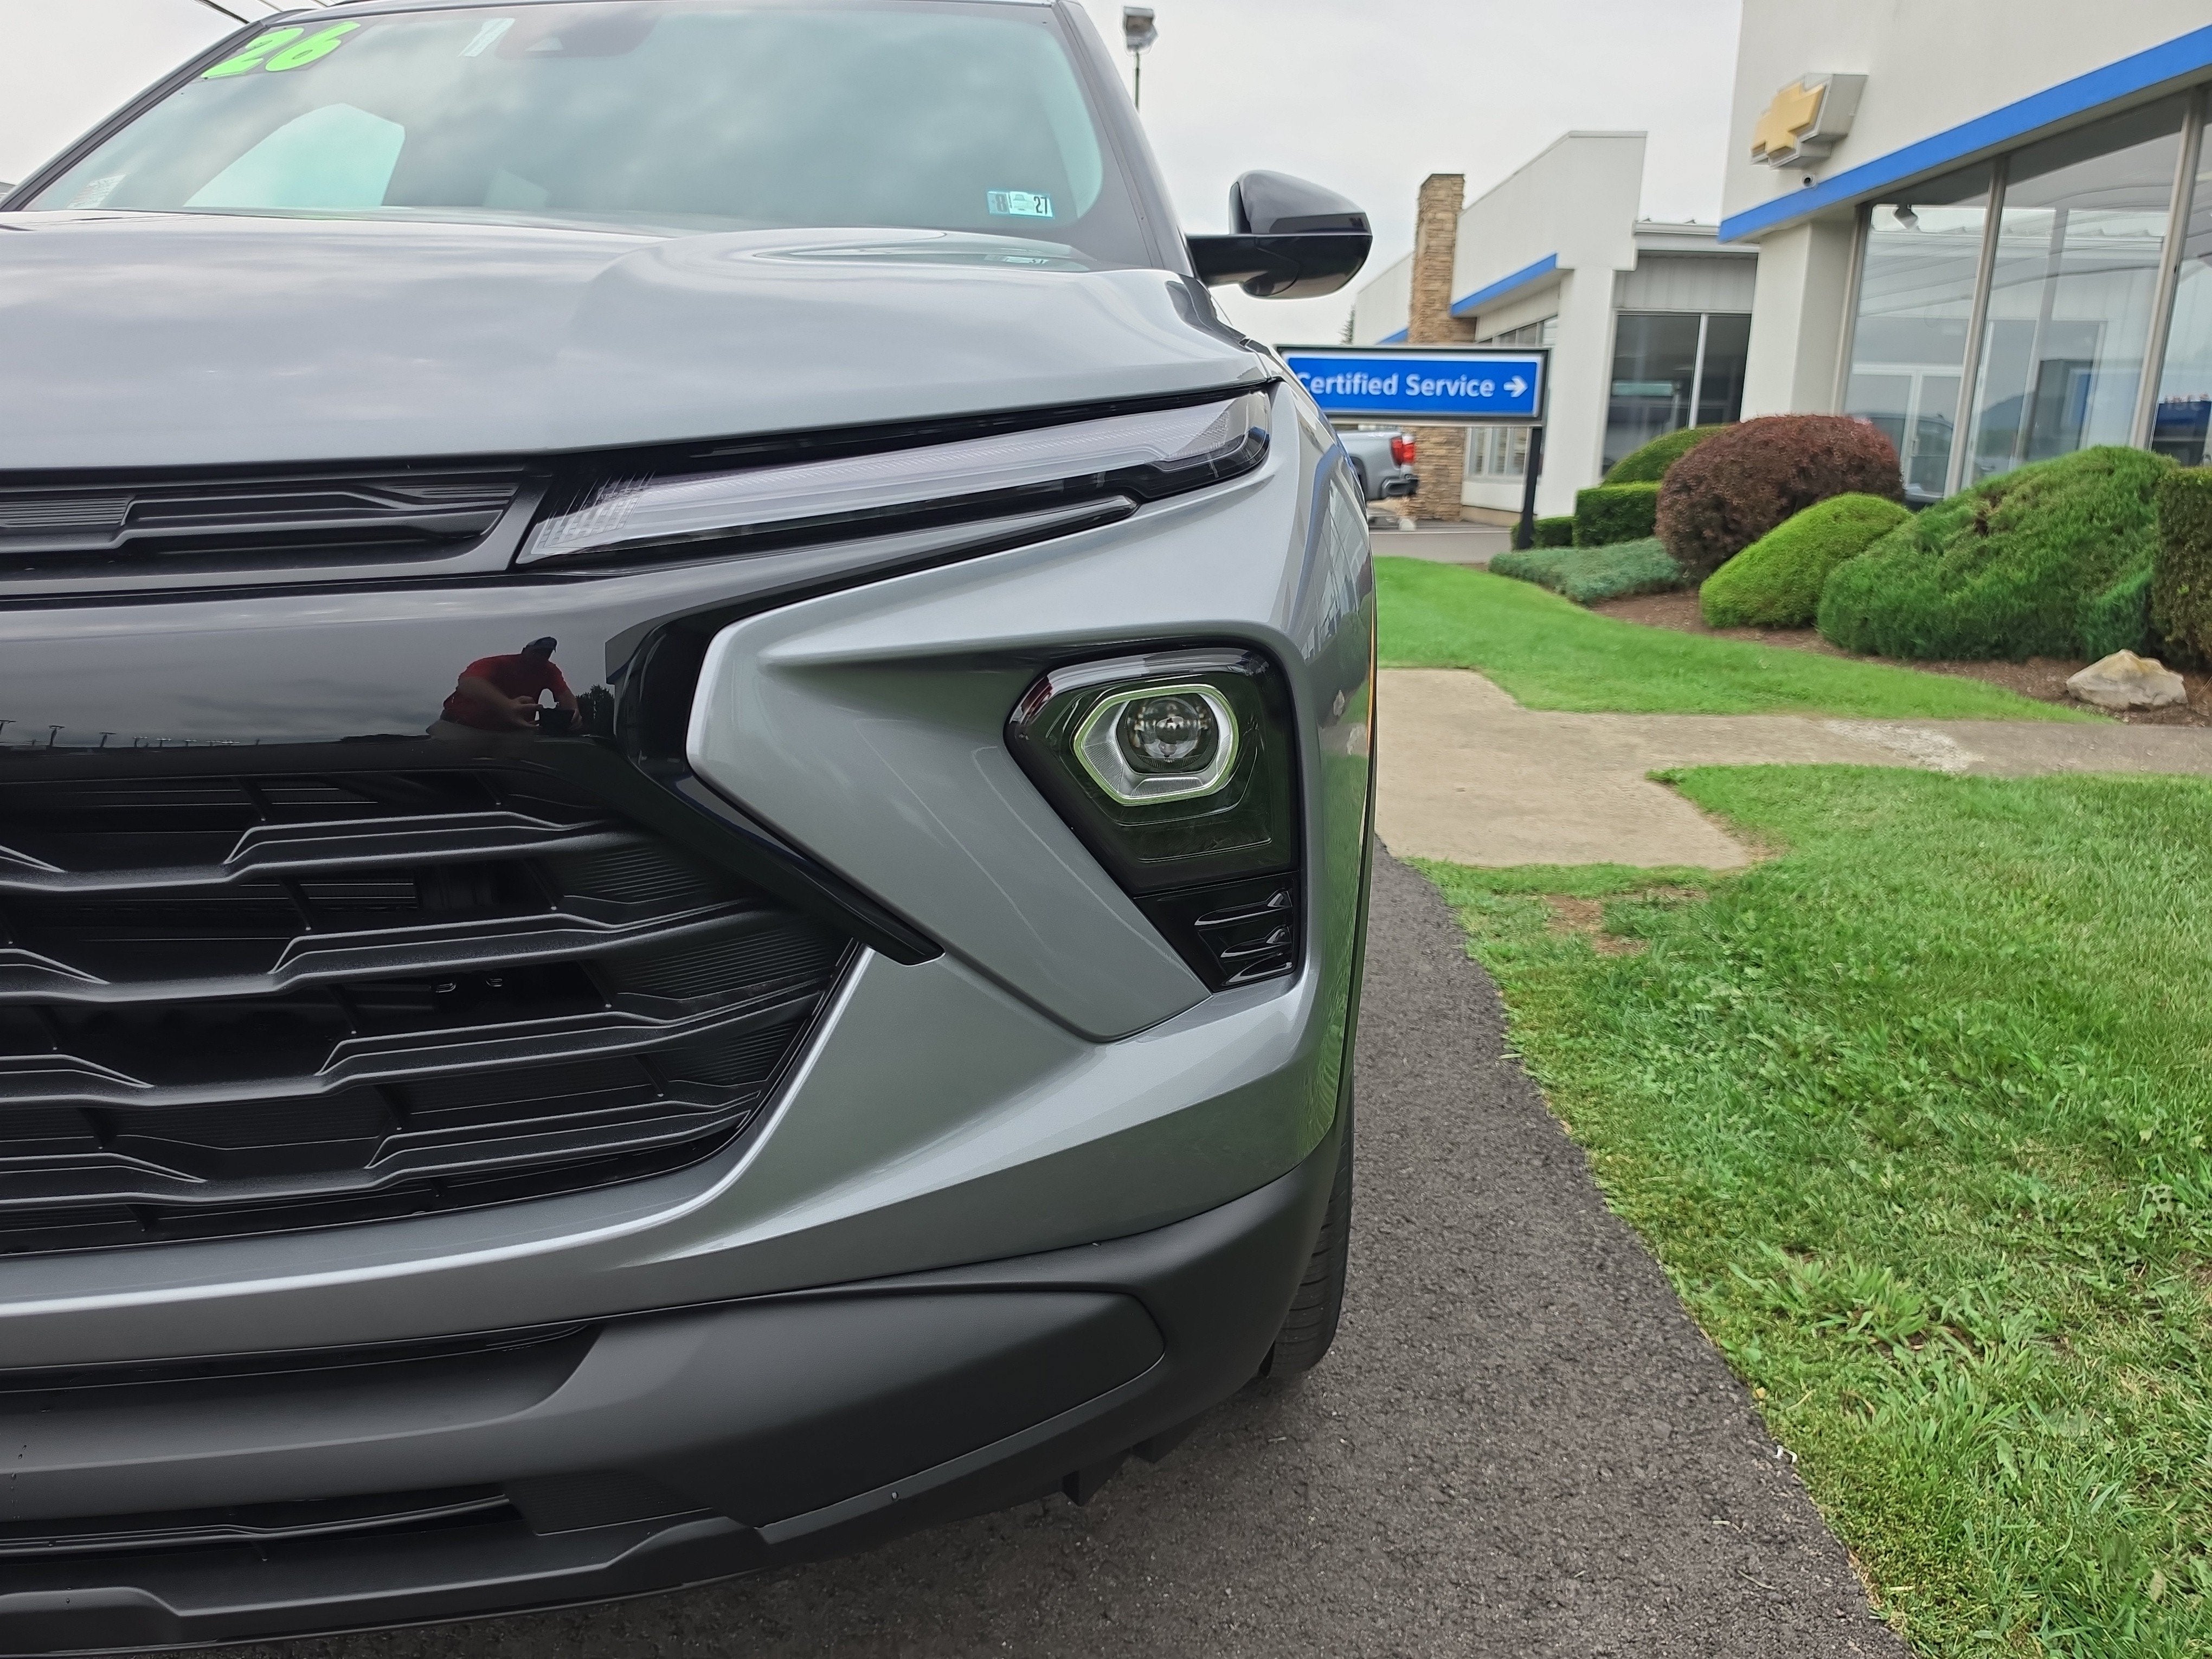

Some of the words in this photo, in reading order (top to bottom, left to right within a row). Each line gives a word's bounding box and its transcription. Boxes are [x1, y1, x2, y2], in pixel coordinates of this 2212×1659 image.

[200, 21, 362, 79] 26
[1033, 196, 1048, 215] 27
[1405, 372, 1496, 397] Service
